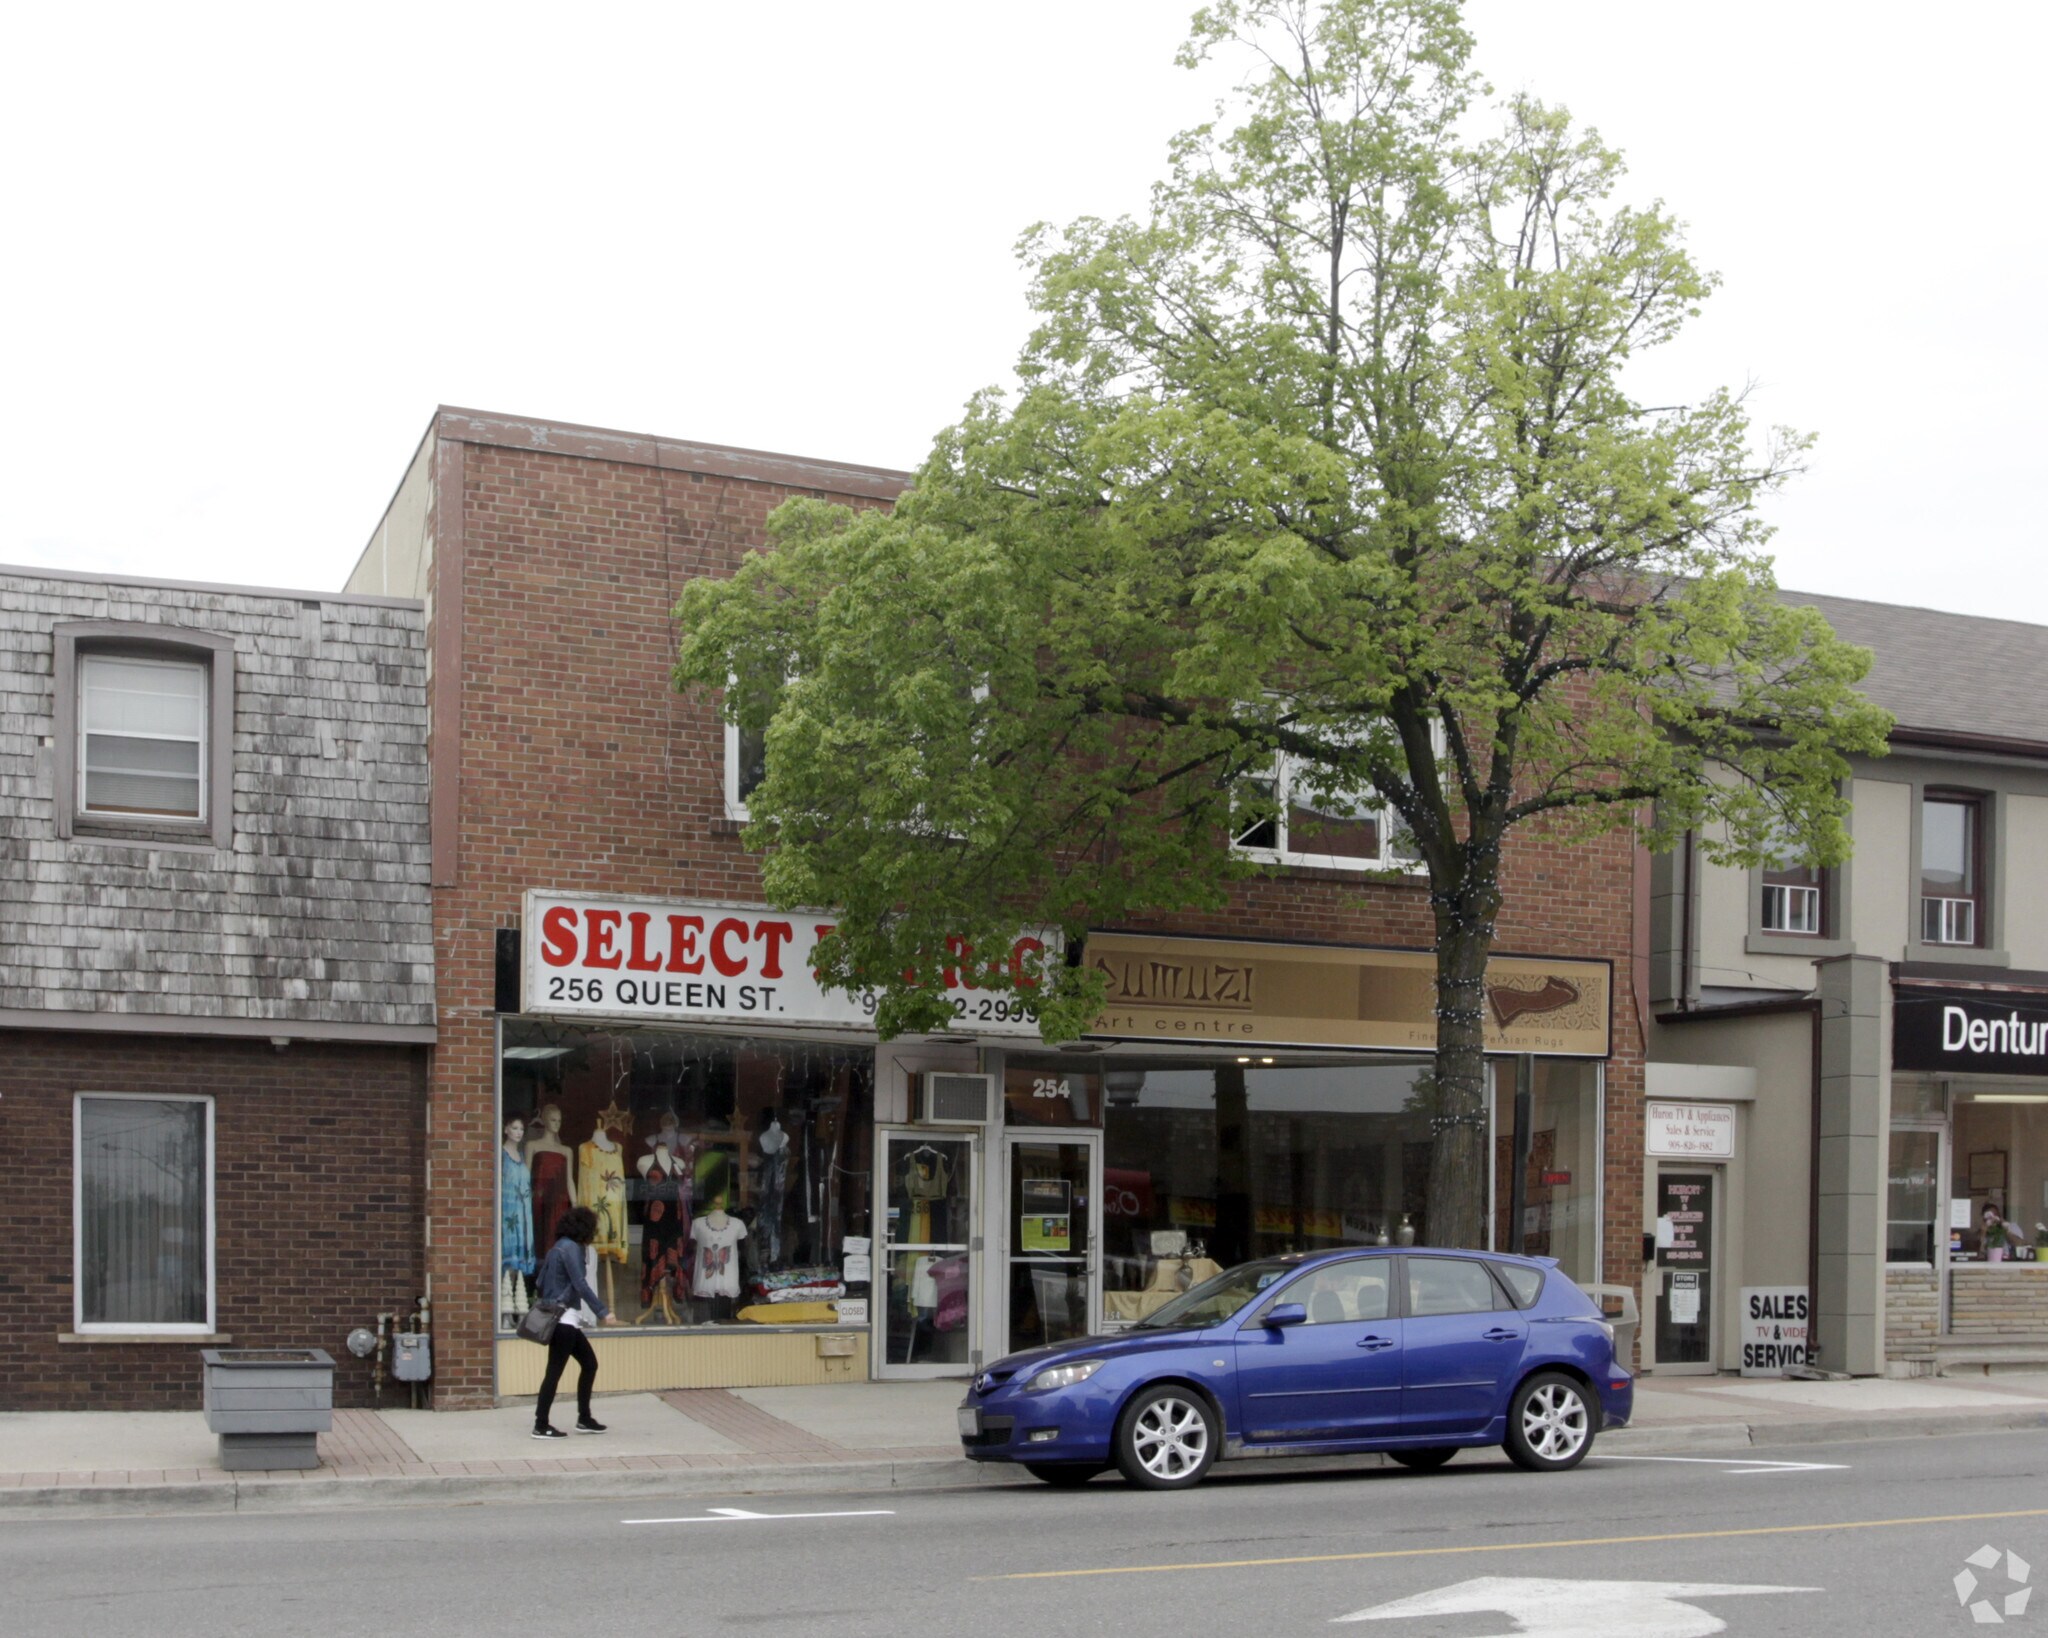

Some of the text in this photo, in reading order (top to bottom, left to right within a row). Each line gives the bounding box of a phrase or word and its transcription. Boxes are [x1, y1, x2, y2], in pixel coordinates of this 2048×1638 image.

[541, 906, 793, 979] SELECT
[549, 977, 784, 1012] 256 QUEEN ST.
[1095, 1015, 1253, 1034] Art centre
[1409, 1031, 1564, 1048] Fine Persian Rugs
[1032, 1078, 1071, 1099] 254
[1652, 1107, 1731, 1125] Huron TV & Appliances
[1666, 1124, 1716, 1137] Sales & Service
[841, 1307, 865, 1316] CLOSED
[1750, 1294, 1808, 1320] SALES
[1756, 1324, 1808, 1341] TV & VIDE
[1744, 1343, 1816, 1368] SERVICE
